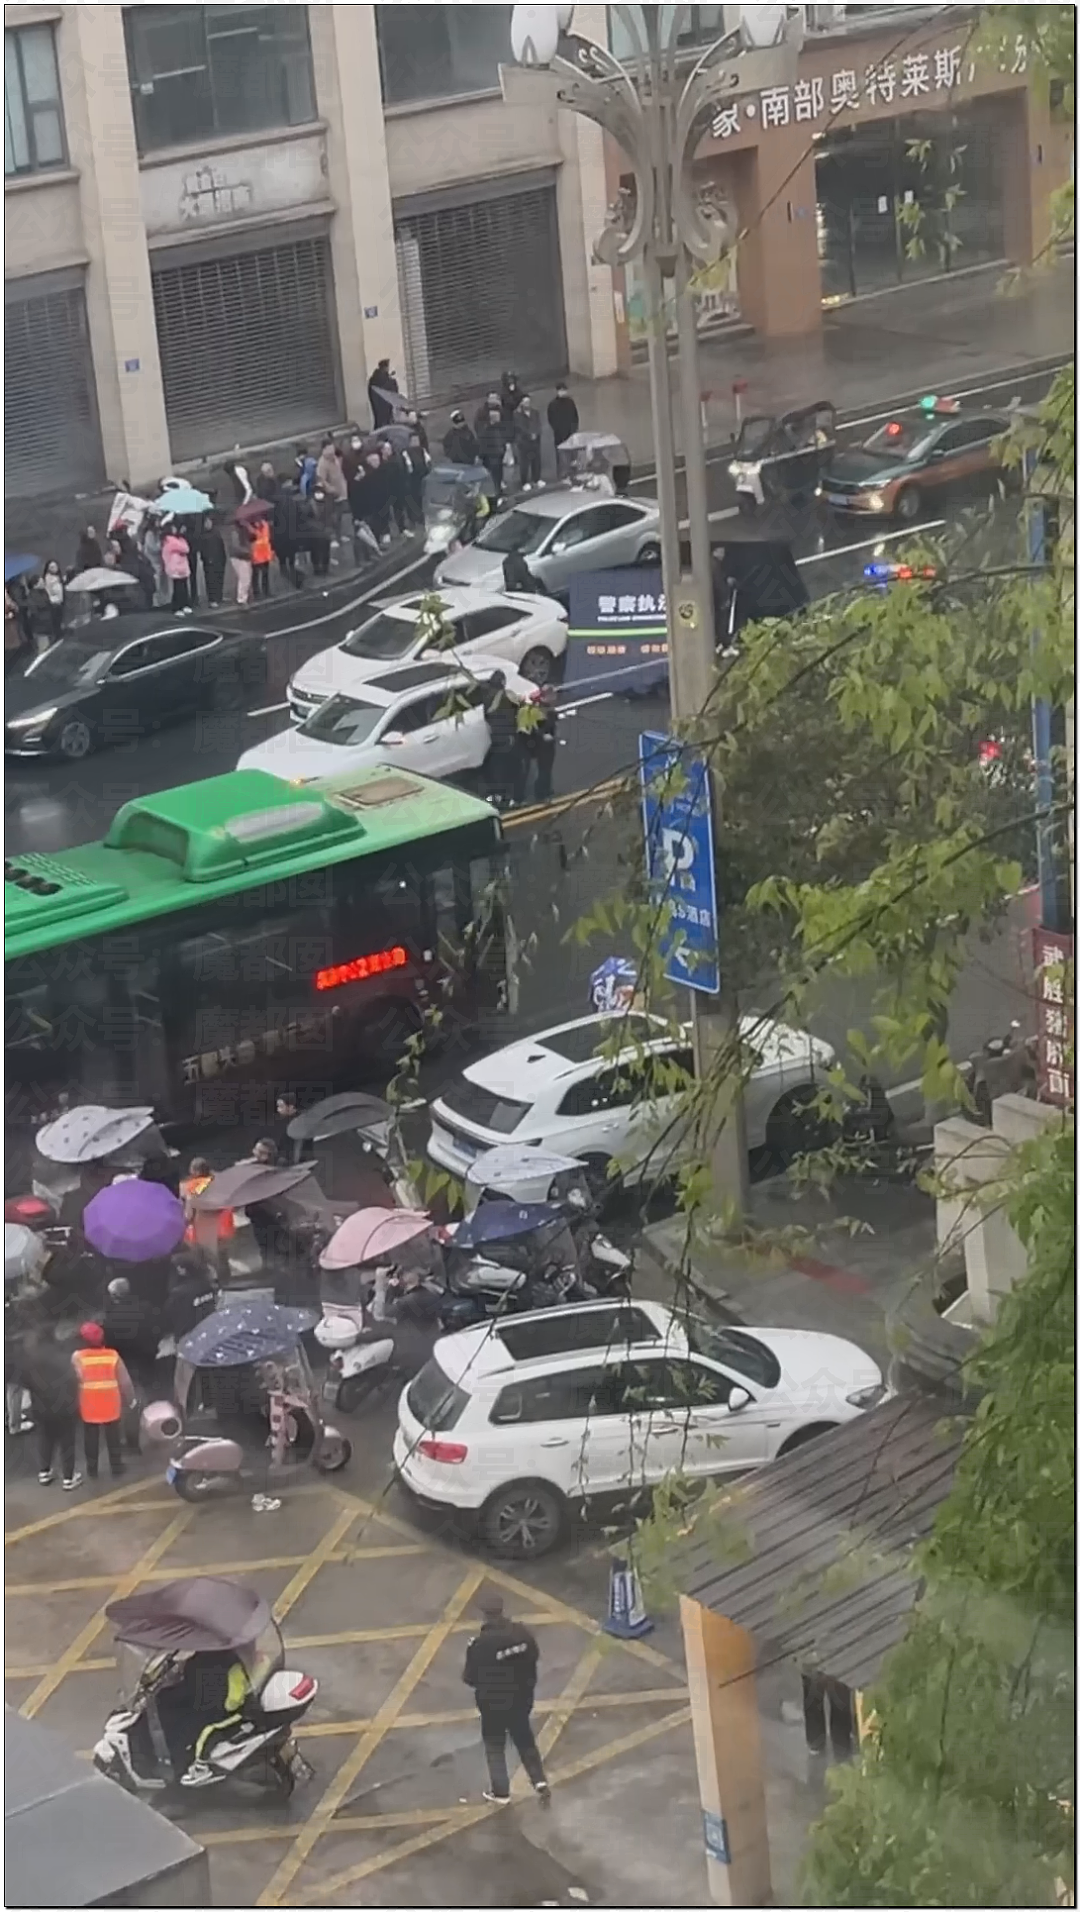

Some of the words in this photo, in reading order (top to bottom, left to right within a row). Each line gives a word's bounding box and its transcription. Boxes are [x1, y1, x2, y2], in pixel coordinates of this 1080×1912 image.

[712, 35, 1027, 139] 家·南部奥特莱斯
